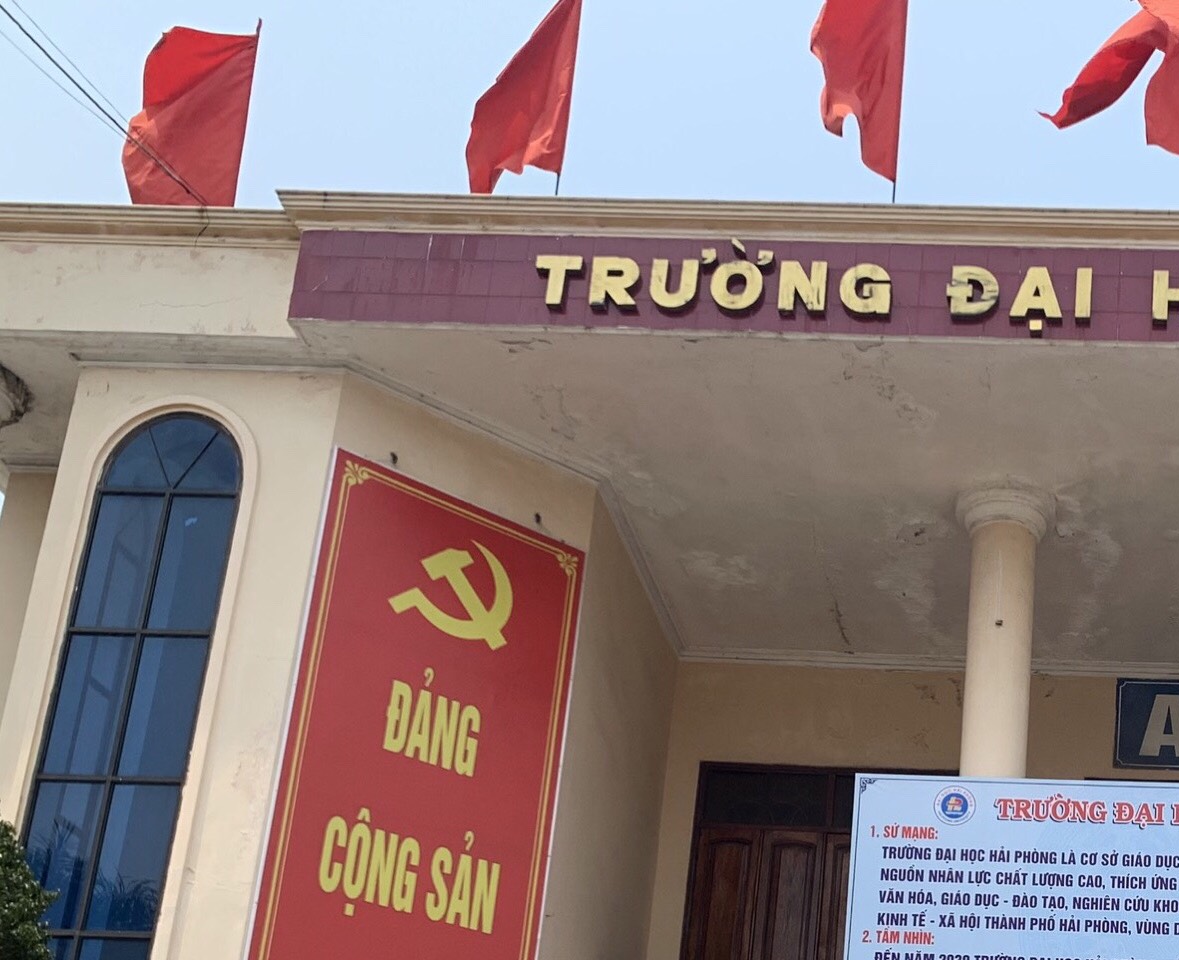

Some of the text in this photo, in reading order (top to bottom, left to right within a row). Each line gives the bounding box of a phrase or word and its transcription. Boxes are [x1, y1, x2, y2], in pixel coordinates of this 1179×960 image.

[536, 238, 891, 315] TRƯỜNG
[946, 265, 1093, 336] ĐẠI
[382, 667, 481, 777] ĐẢNG
[994, 793, 1108, 823] TRƯỜNG
[1113, 802, 1165, 829] ĐẠI
[870, 825, 879, 838] 1.
[319, 807, 501, 934] CỘNG SẢN
[881, 843, 931, 861] TRƯỜNG
[935, 848, 956, 865] ĐẠI
[960, 849, 985, 866] HỌC
[989, 846, 1010, 863] HẢI
[1014, 847, 1057, 865] PHÒNG
[1061, 849, 1076, 865] LÀ
[1080, 853, 1098, 866] CƠ
[1100, 850, 1119, 867] SỞ
[1121, 851, 1151, 868] GIÁO
[1155, 855, 1179, 872] DỤC
[880, 863, 924, 883] NGUỒN
[928, 867, 964, 884] NHÂN
[967, 871, 991, 888] LỰC
[995, 867, 1028, 886] CHẤT
[1031, 873, 1073, 890] LƯỢNG
[1077, 875, 1105, 890] CAO,
[1109, 872, 1146, 890] THÍCH
[1151, 873, 1177, 890] ỨNG
[878, 887, 904, 904] VĂN
[907, 888, 937, 907] HÓA,
[940, 889, 970, 906] GIÁO
[974, 894, 999, 911] DỤC
[1011, 892, 1037, 908] ĐÀO
[1041, 896, 1068, 913] TẠO,
[1072, 894, 1120, 911] NGHIÊN
[1124, 895, 1149, 912] CỨU
[861, 930, 872, 943] 2.
[876, 913, 908, 927] KINH
[911, 909, 926, 927] TẾ
[938, 912, 955, 928] XÃ
[959, 912, 980, 932] HỘI
[984, 913, 1026, 931] THÀNH
[1029, 912, 1055, 932] PHỐ
[1059, 915, 1080, 932] HẢI
[1084, 916, 1131, 936] PHÒNG,
[1135, 918, 1169, 935] VÙNG
